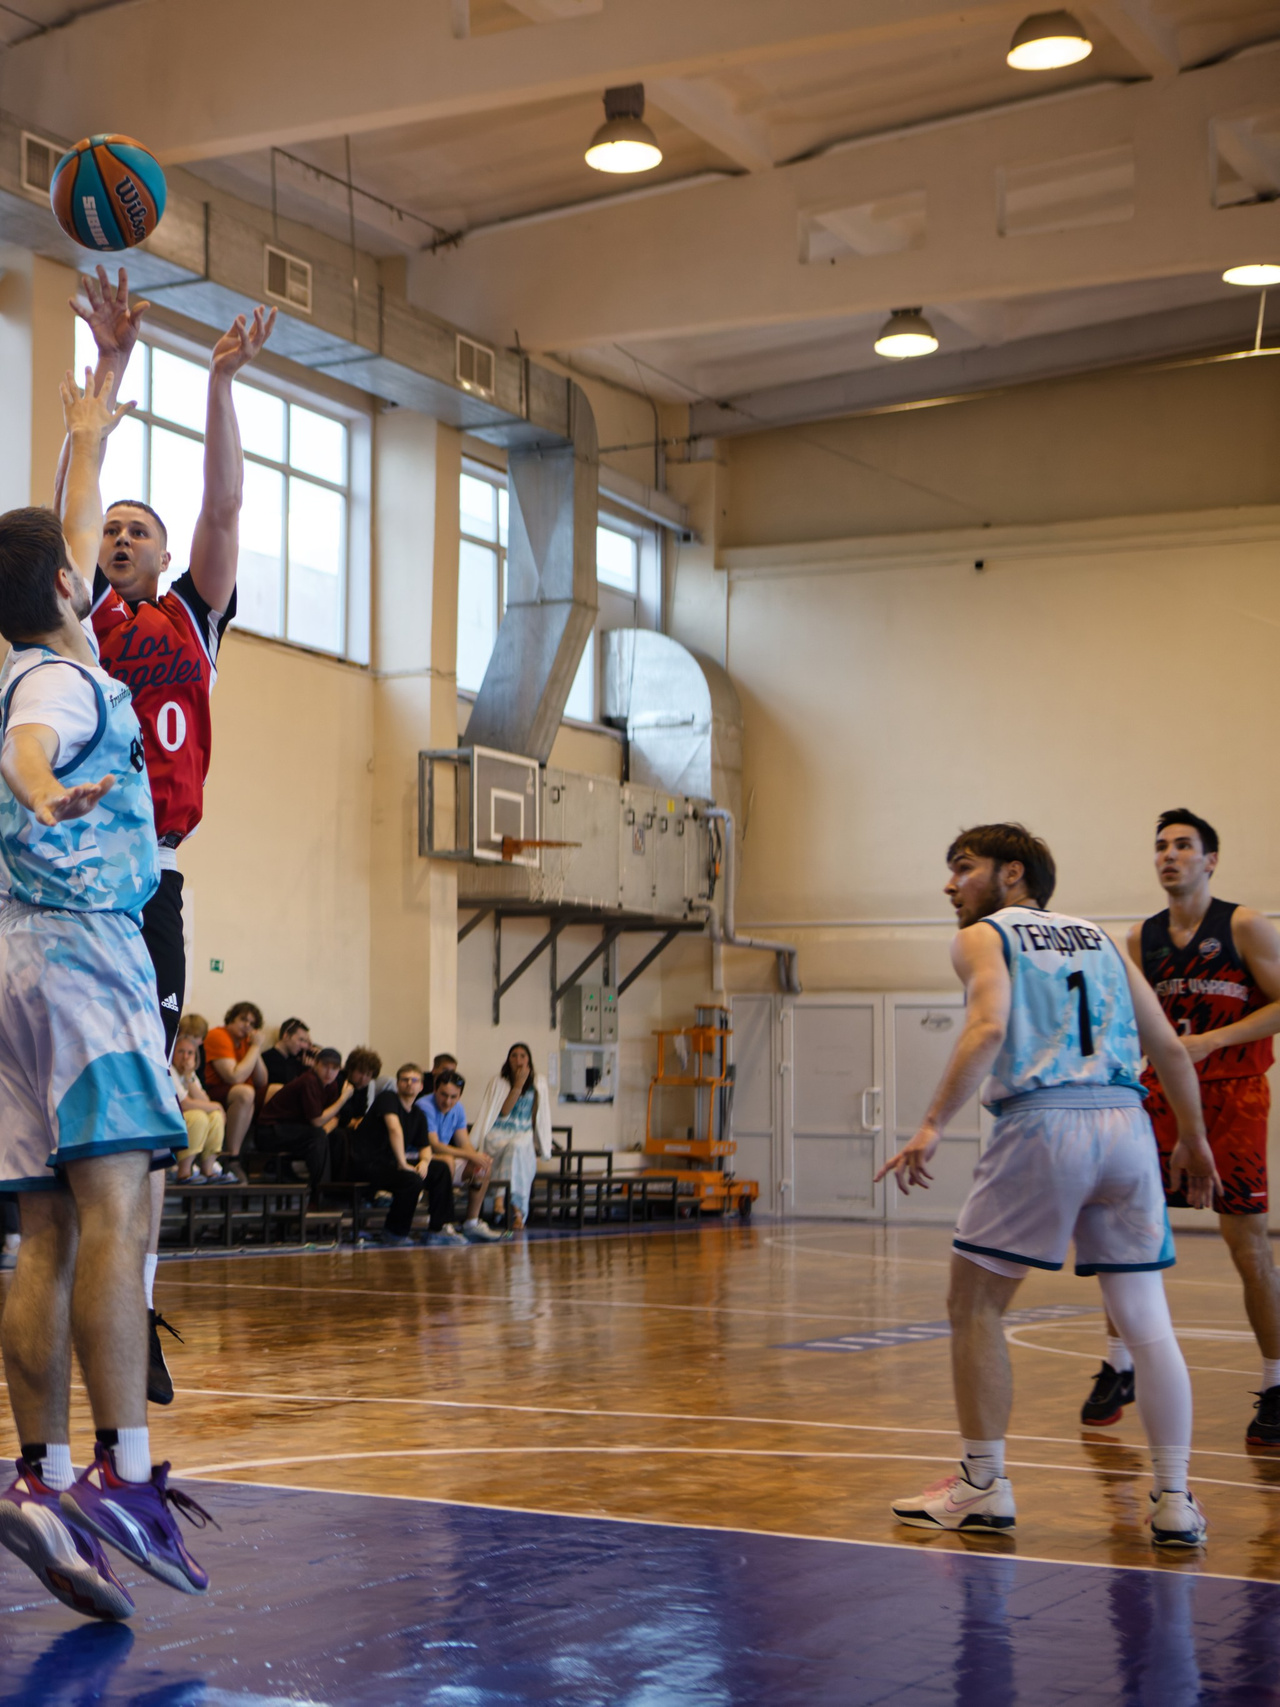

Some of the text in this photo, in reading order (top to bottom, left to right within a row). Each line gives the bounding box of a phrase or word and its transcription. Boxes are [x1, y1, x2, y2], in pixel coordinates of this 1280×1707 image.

[116, 625, 173, 662] Los
[157, 701, 186, 752] 0
[1066, 970, 1095, 1057] 1
